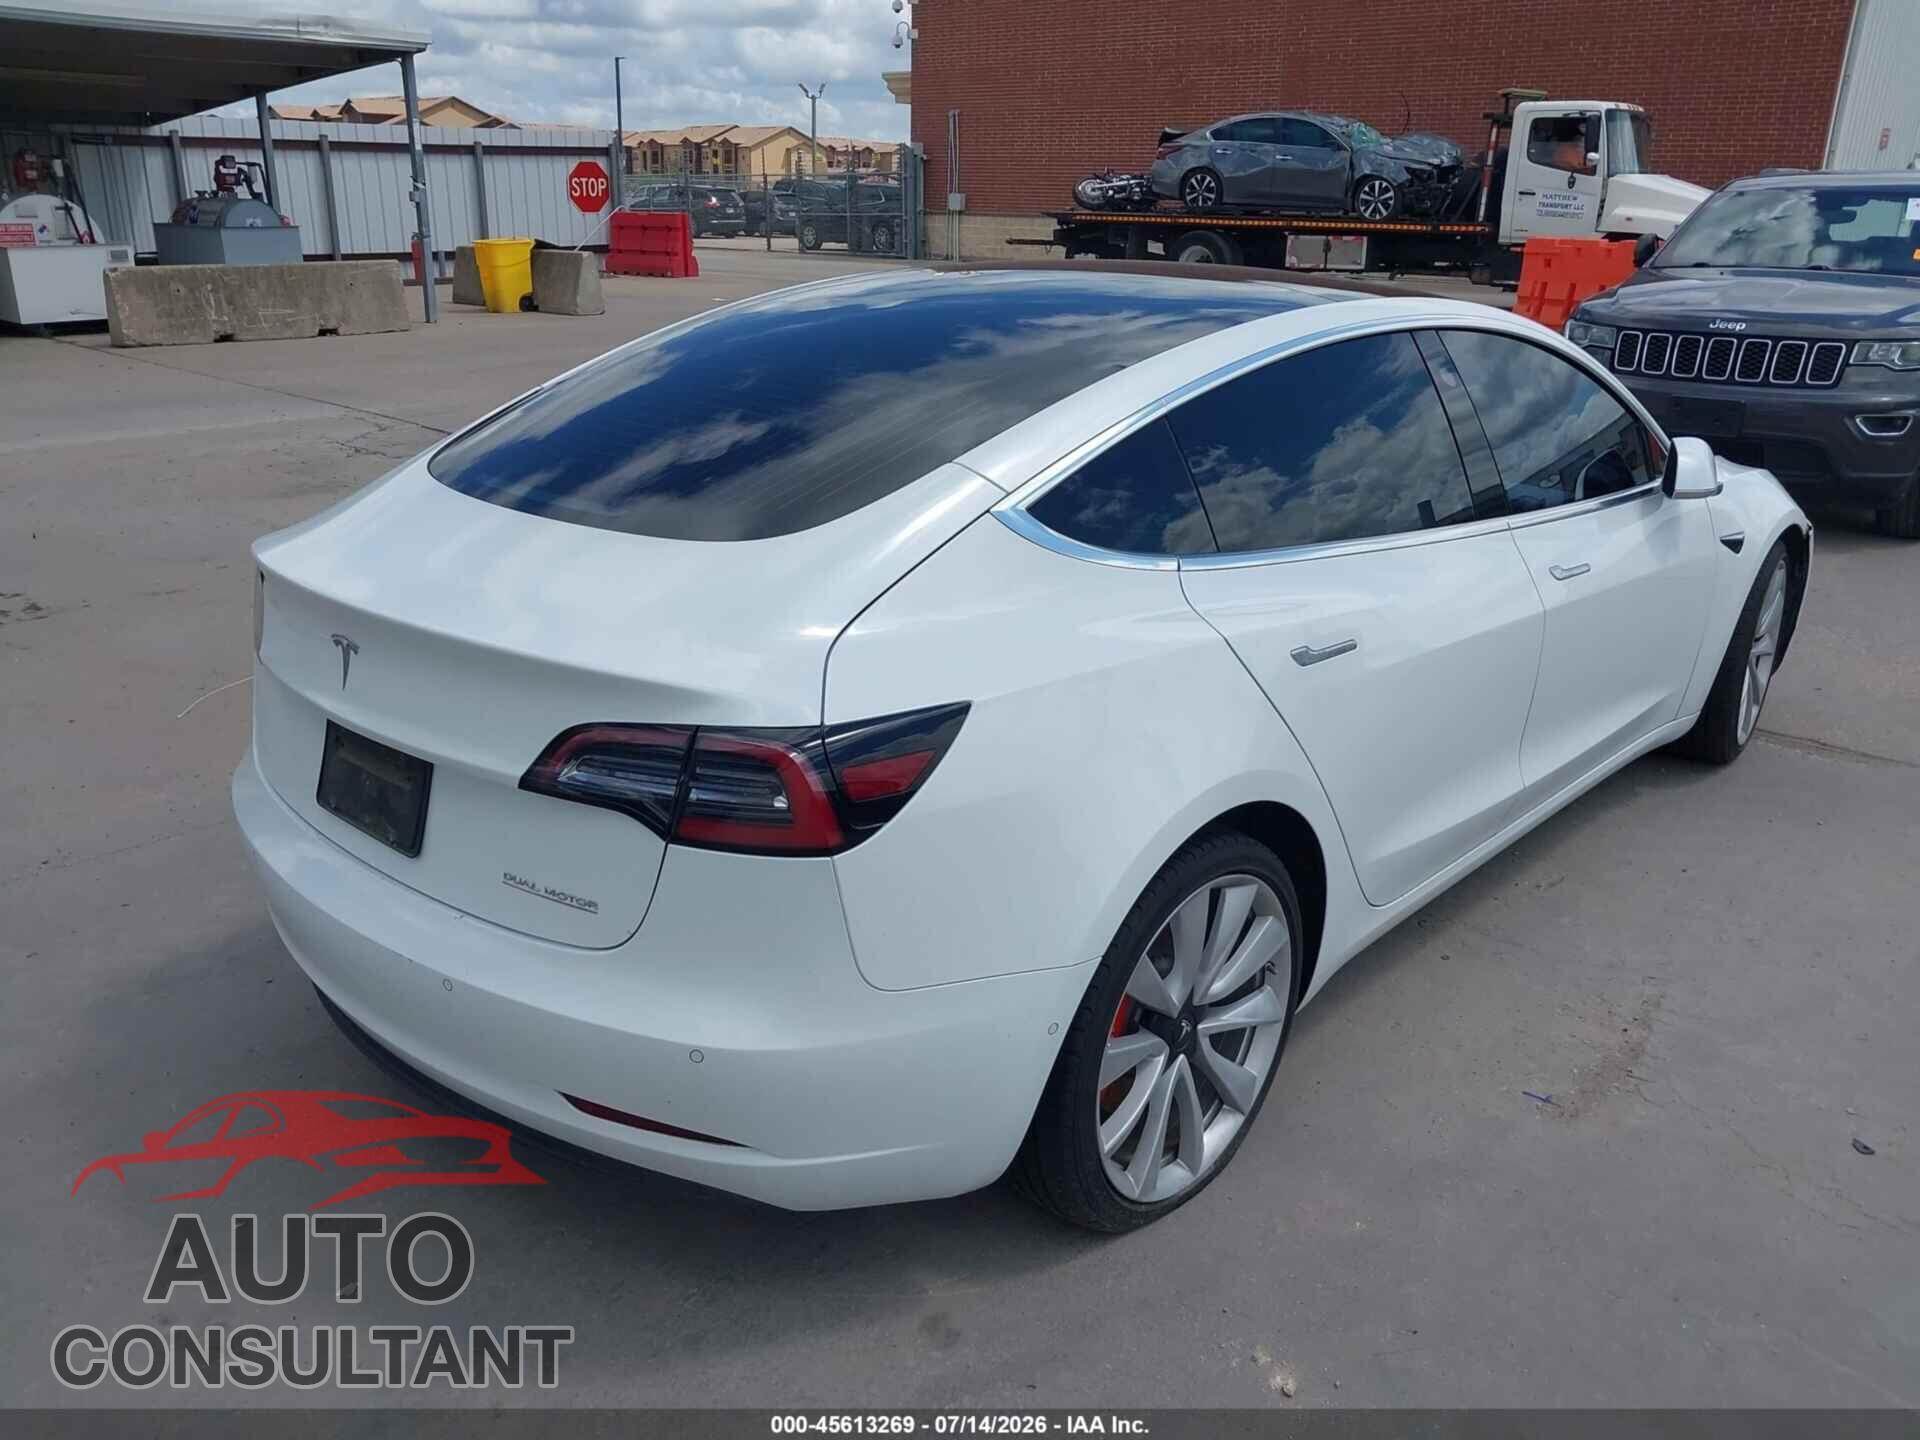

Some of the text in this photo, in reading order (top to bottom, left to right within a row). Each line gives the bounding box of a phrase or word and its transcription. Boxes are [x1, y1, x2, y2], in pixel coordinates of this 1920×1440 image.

[572, 177, 607, 197] STOP
[1709, 319, 1746, 331] Jeep
[503, 872, 599, 910] DUAL MOTOR
